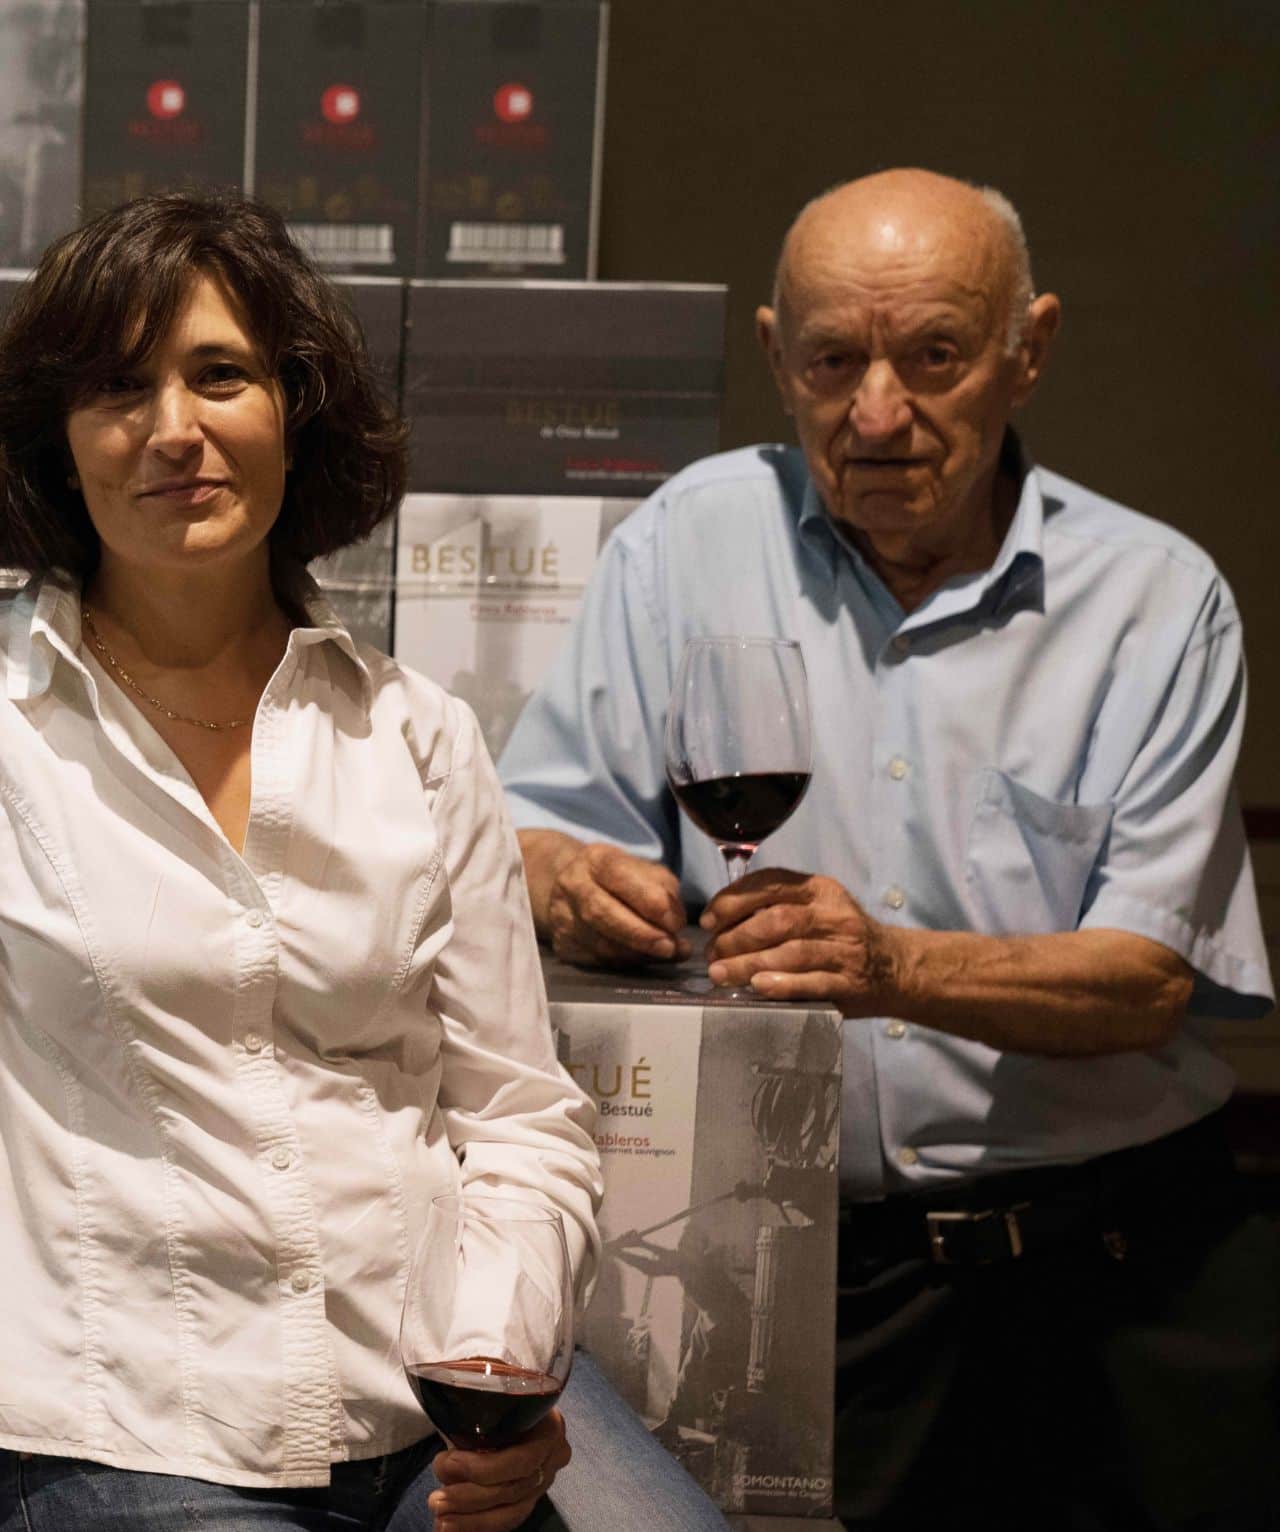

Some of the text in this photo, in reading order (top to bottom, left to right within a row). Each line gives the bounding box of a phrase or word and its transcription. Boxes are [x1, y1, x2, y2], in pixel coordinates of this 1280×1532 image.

[411, 538, 560, 576] BESTUÉ
[567, 1057, 651, 1099] TUÉ
[600, 1102, 653, 1117] Bestué
